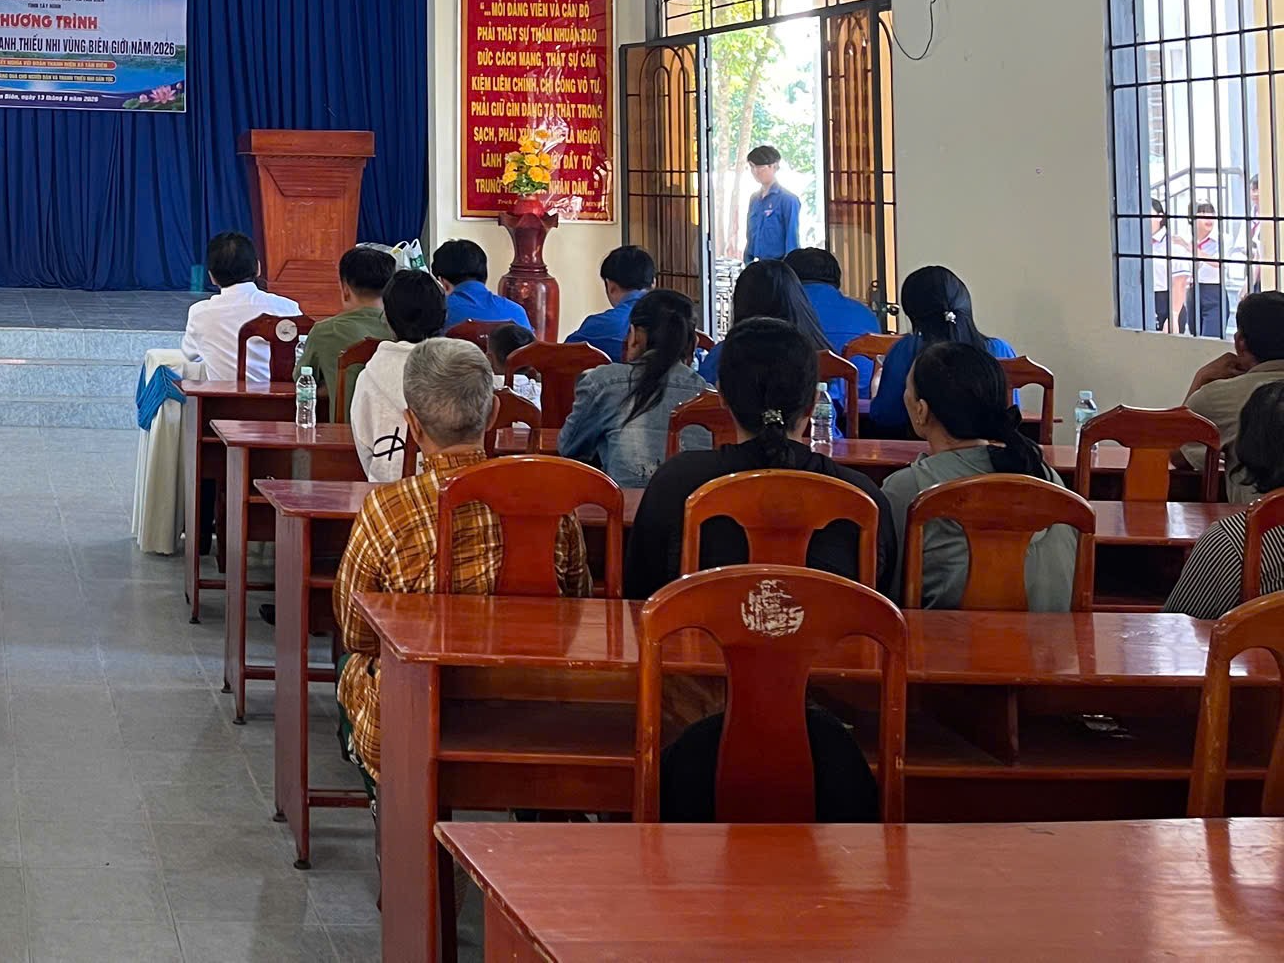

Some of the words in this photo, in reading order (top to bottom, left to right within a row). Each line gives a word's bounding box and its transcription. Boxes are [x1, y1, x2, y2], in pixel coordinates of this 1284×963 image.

[56, 13, 98, 29] TRÌNH
[530, 0, 549, 17] VIÊN
[550, 0, 560, 17] VÀ
[562, 0, 577, 17] CÁN
[579, 1, 590, 21] BỘ
[477, 21, 495, 41] PHẢI
[497, 24, 517, 44] THẬT
[519, 25, 530, 45] SỰ
[18, 34, 43, 51] THIẾU
[46, 38, 60, 52] NHI
[63, 37, 86, 53] VÙNG
[89, 37, 108, 53] BIÊN
[111, 38, 128, 54] GIỚI
[131, 39, 151, 55] NĂM
[153, 42, 175, 55] 2026
[496, 48, 516, 66] CÁCH
[568, 50, 579, 71] SỰ
[471, 73, 491, 94] KIỆM
[493, 74, 511, 92] LIÊM
[577, 76, 588, 93] VÔ
[471, 97, 489, 116] PHẢI
[491, 98, 505, 116] GIỮ
[577, 104, 602, 118] TRONG
[499, 123, 517, 142] PHẢI
[481, 149, 502, 167] LÃNH
